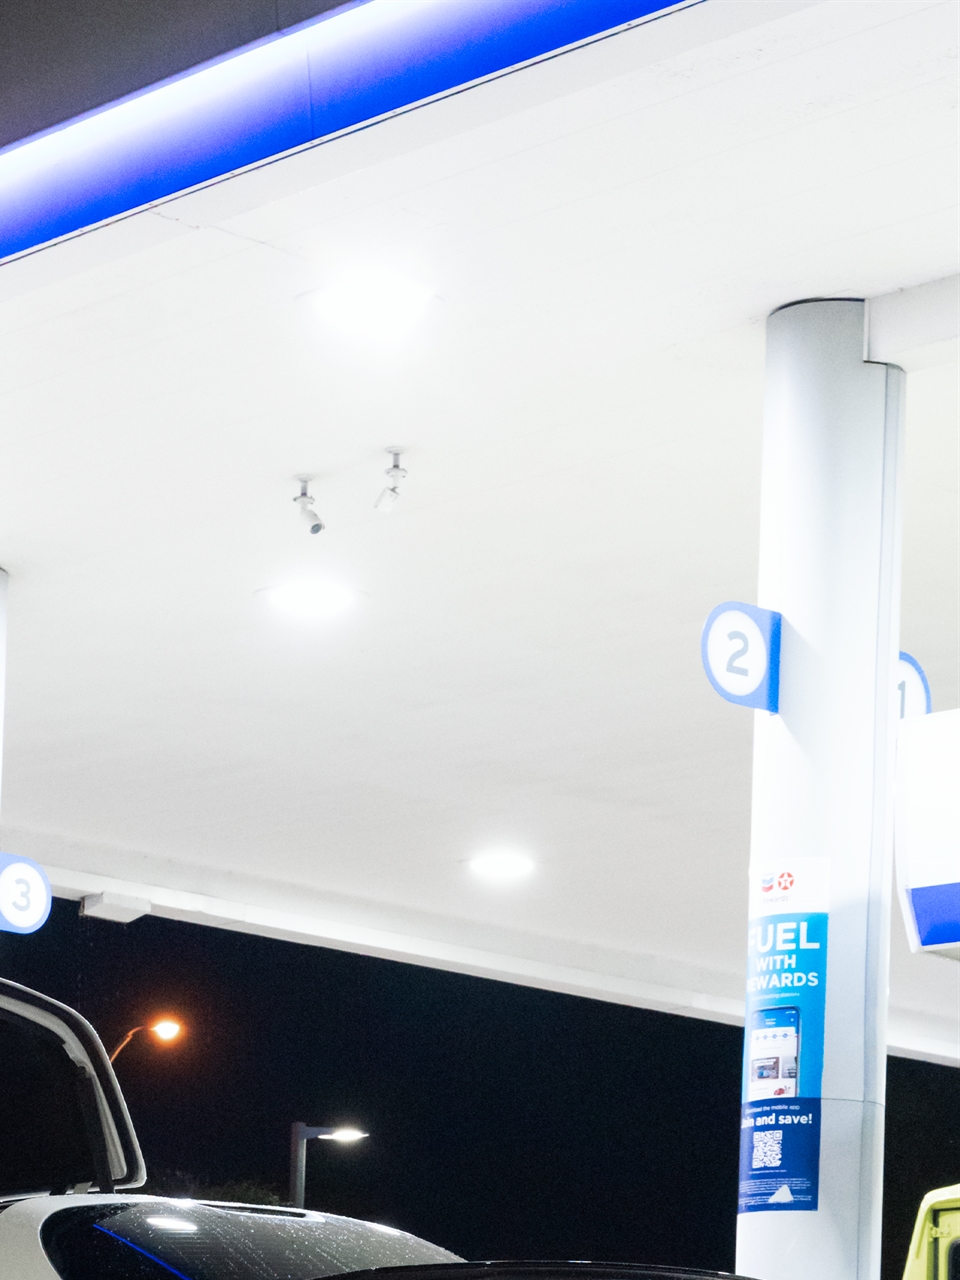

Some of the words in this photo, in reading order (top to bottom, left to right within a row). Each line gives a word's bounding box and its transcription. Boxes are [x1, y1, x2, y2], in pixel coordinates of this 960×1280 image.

[726, 630, 749, 677] 2
[897, 680, 906, 719] 1
[12, 878, 31, 911] 3
[756, 954, 796, 972] WITH
[755, 1113, 775, 1126] and
[778, 1113, 813, 1125] save!
